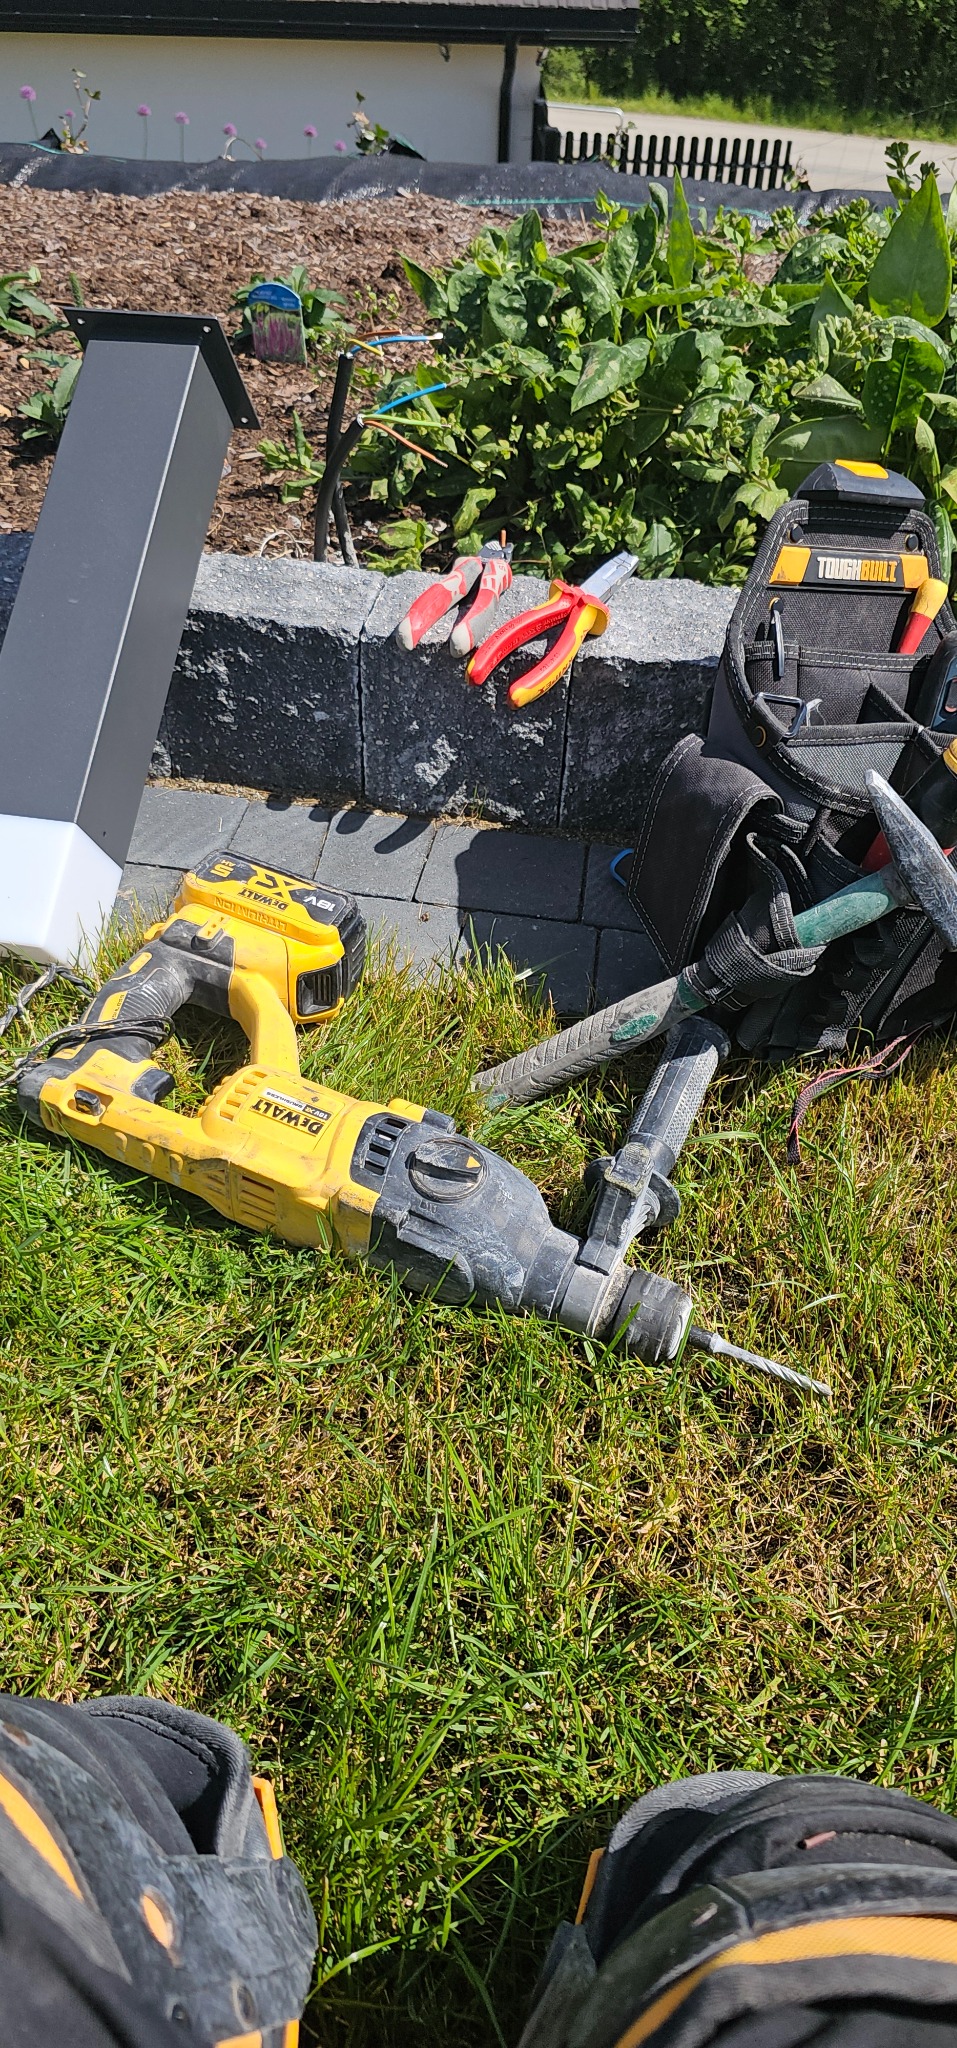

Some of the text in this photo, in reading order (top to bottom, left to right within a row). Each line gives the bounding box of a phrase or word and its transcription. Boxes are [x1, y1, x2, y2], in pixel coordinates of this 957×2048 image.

[817, 556, 898, 583] TOUGHBUILT
[210, 862, 235, 878] 5
[213, 897, 289, 932] LITHIUM ION
[303, 895, 337, 913] 18V
